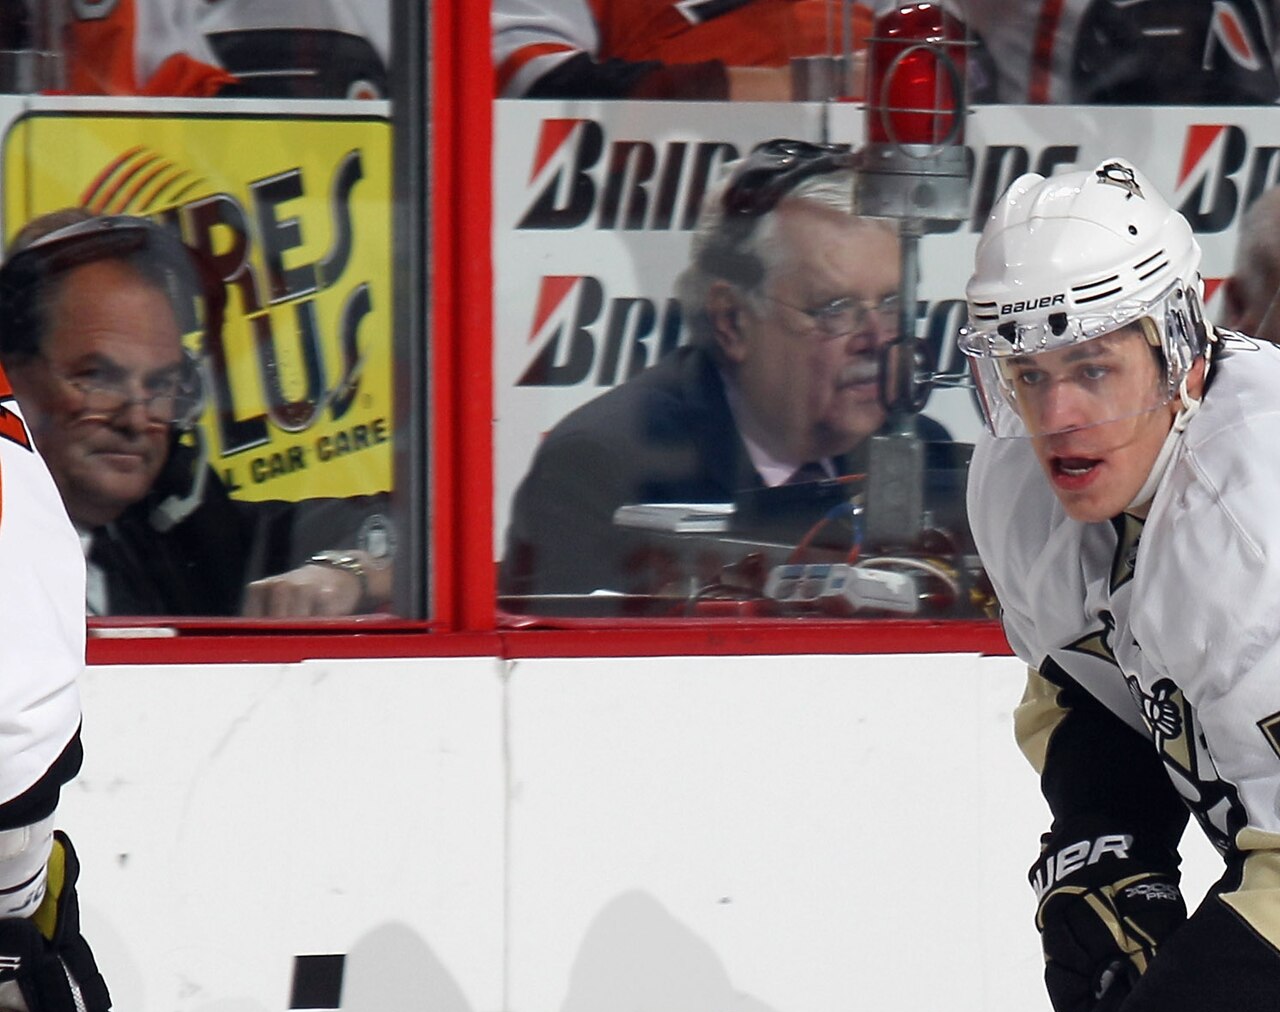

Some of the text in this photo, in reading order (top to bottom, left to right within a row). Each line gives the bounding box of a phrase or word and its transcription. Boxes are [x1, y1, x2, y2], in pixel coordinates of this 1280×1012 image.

[178, 149, 364, 314] RES
[1001, 293, 1066, 315] BAUER
[200, 287, 372, 458] LUS
[251, 446, 306, 485] CAR
[316, 417, 389, 462] CARE
